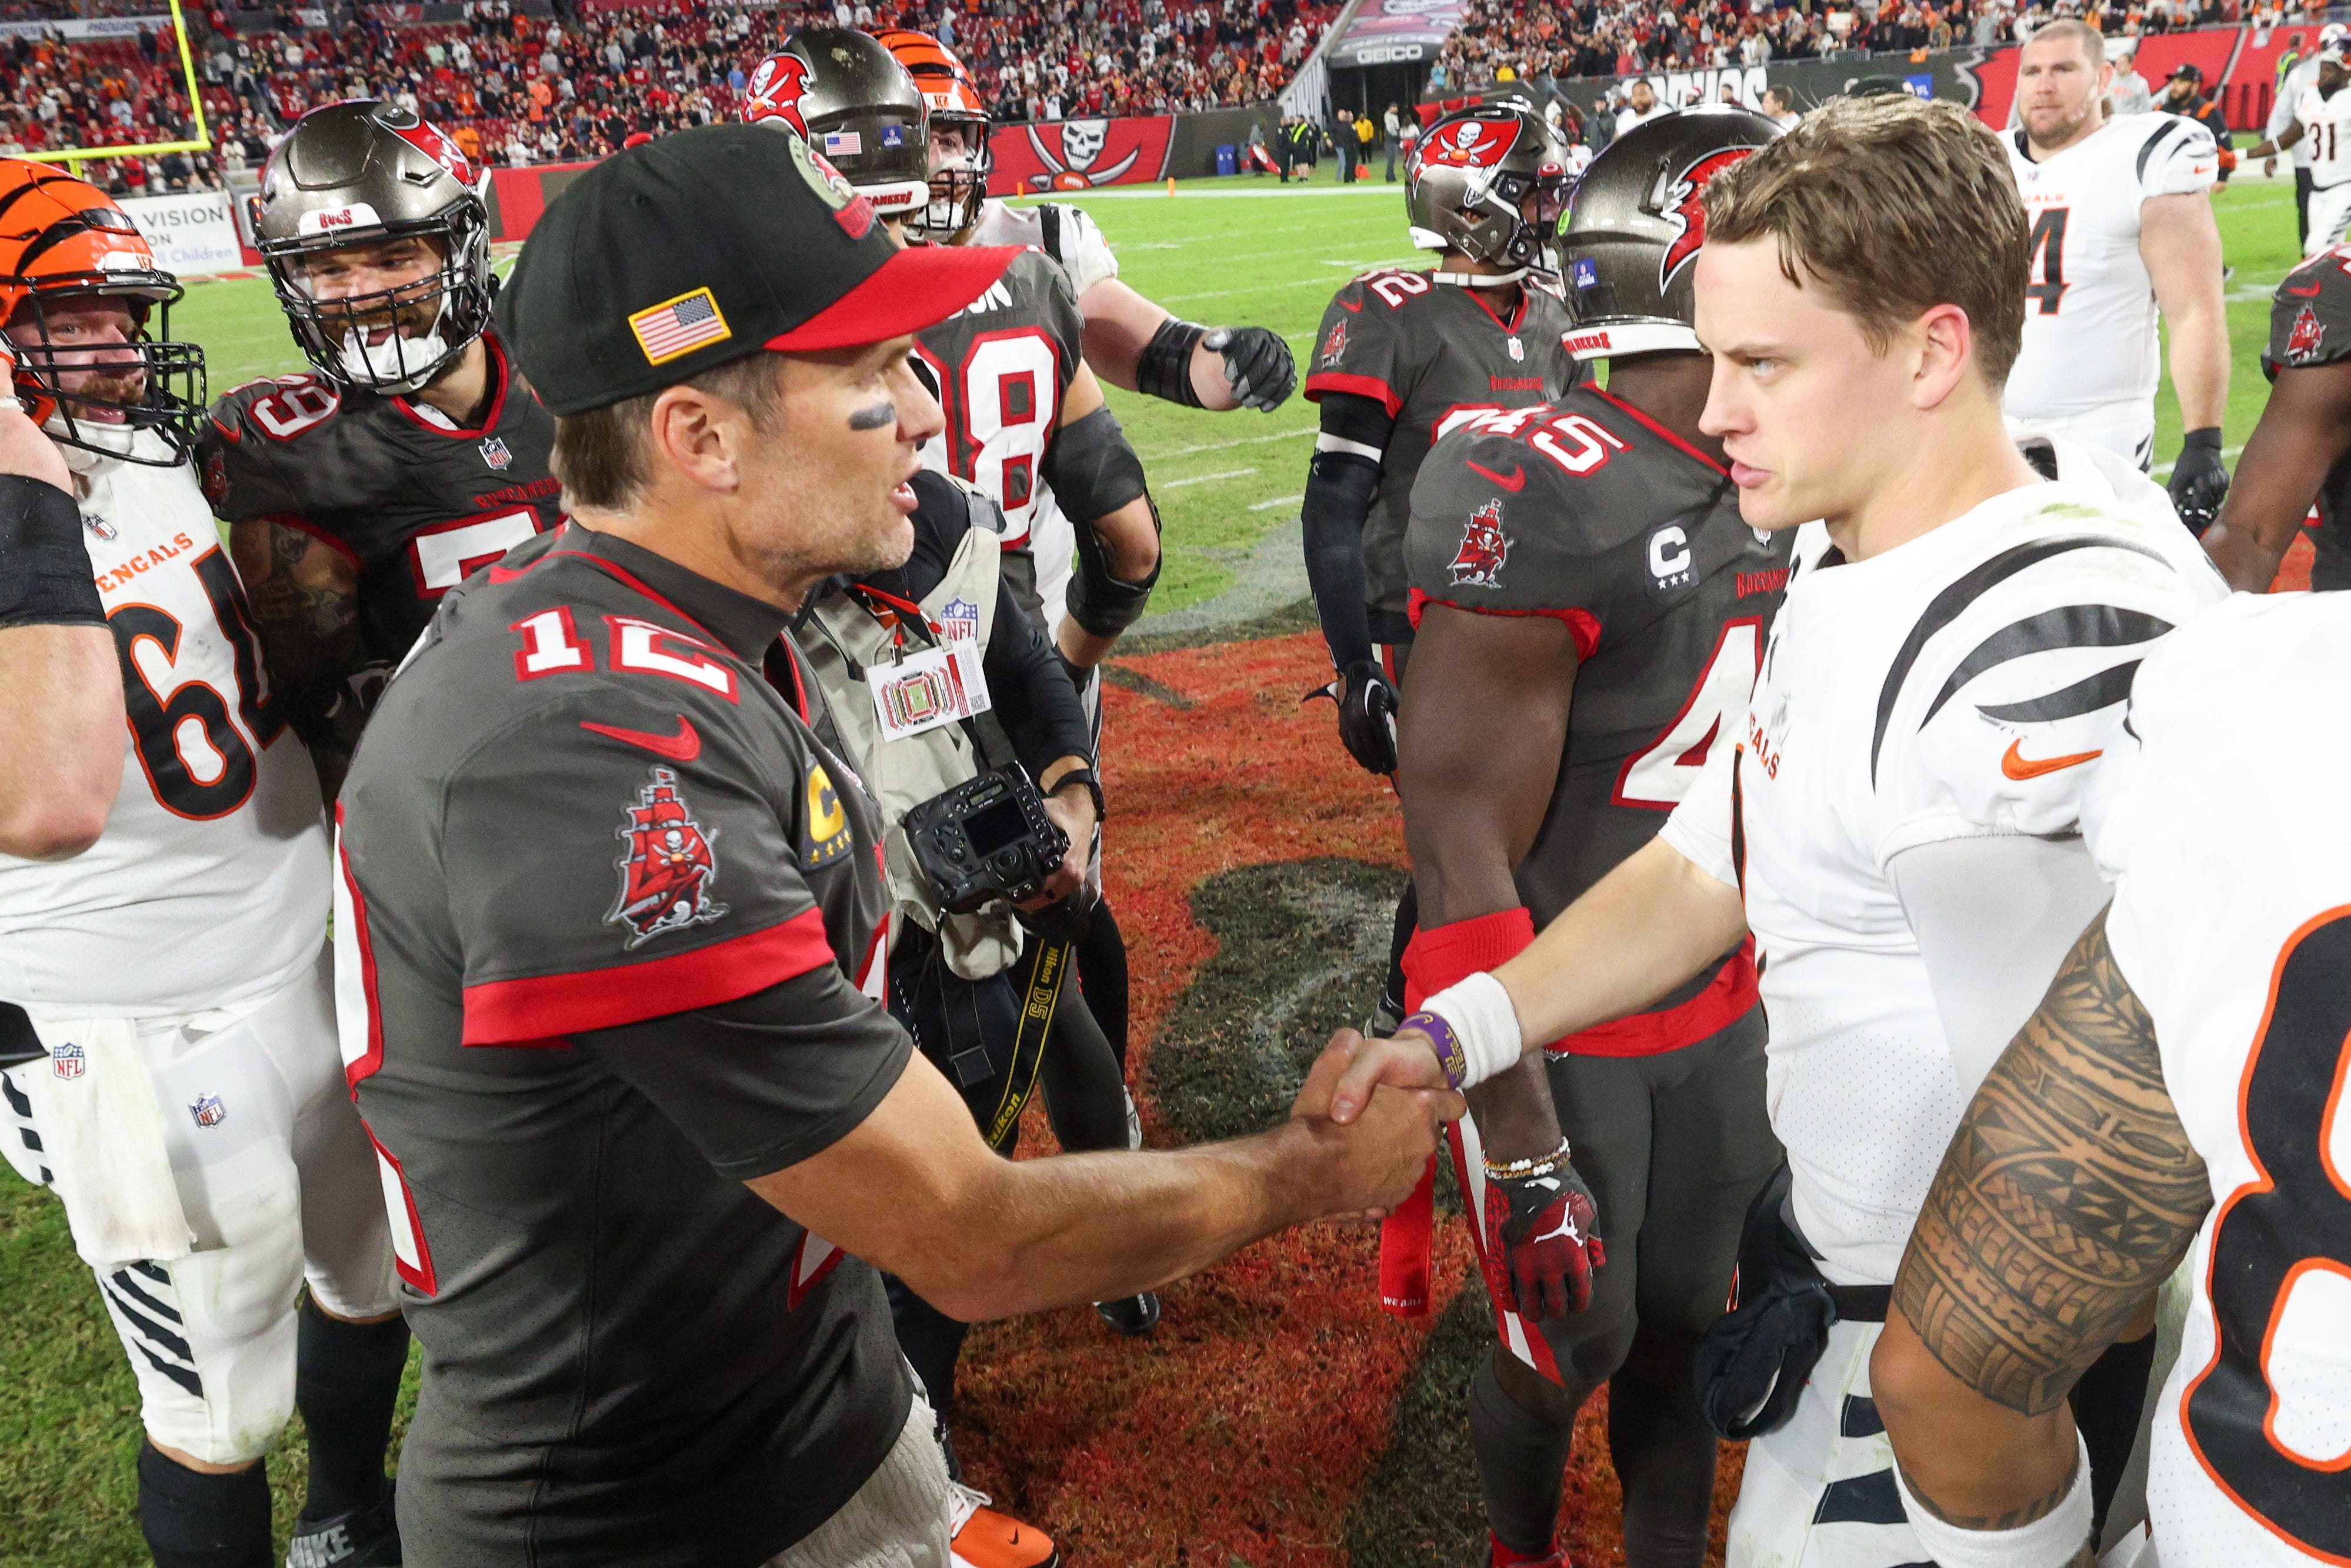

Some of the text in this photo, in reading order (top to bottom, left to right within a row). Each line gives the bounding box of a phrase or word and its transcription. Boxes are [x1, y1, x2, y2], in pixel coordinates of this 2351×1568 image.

[1357, 44, 1423, 64] GEICO
[2308, 122, 2336, 161] 31
[142, 207, 225, 226] VISION
[171, 246, 234, 263] Children
[2023, 207, 2072, 315] 4
[95, 532, 193, 593] ENGALS
[1650, 525, 1691, 578] C
[945, 620, 972, 642] NFL
[808, 764, 845, 843] C
[1028, 945, 1059, 1020] Nikon D5
[56, 1059, 82, 1077] NFL
[199, 1106, 222, 1125] NFL
